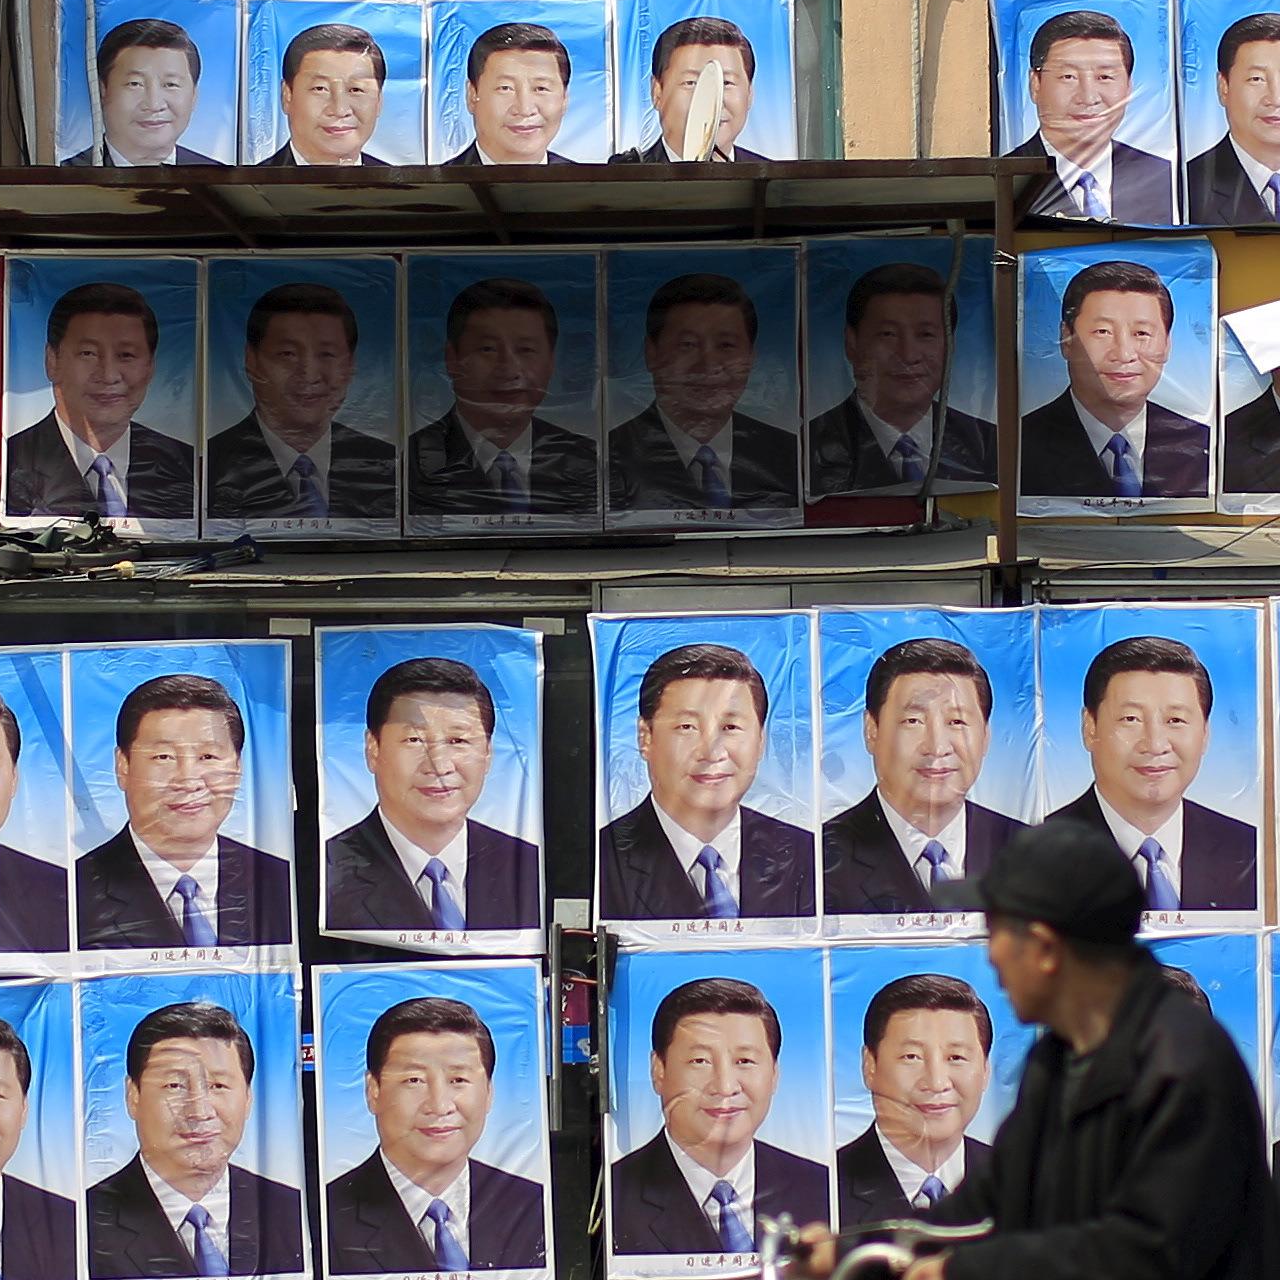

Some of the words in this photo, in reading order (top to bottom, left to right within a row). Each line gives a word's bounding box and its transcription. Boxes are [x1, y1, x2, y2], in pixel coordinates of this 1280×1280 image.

[671, 919, 746, 934] 习近平同志
[398, 932, 471, 944] 习近平同志
[150, 947, 223, 962] 习近平同志
[685, 1253, 760, 1268] 习近平同志
